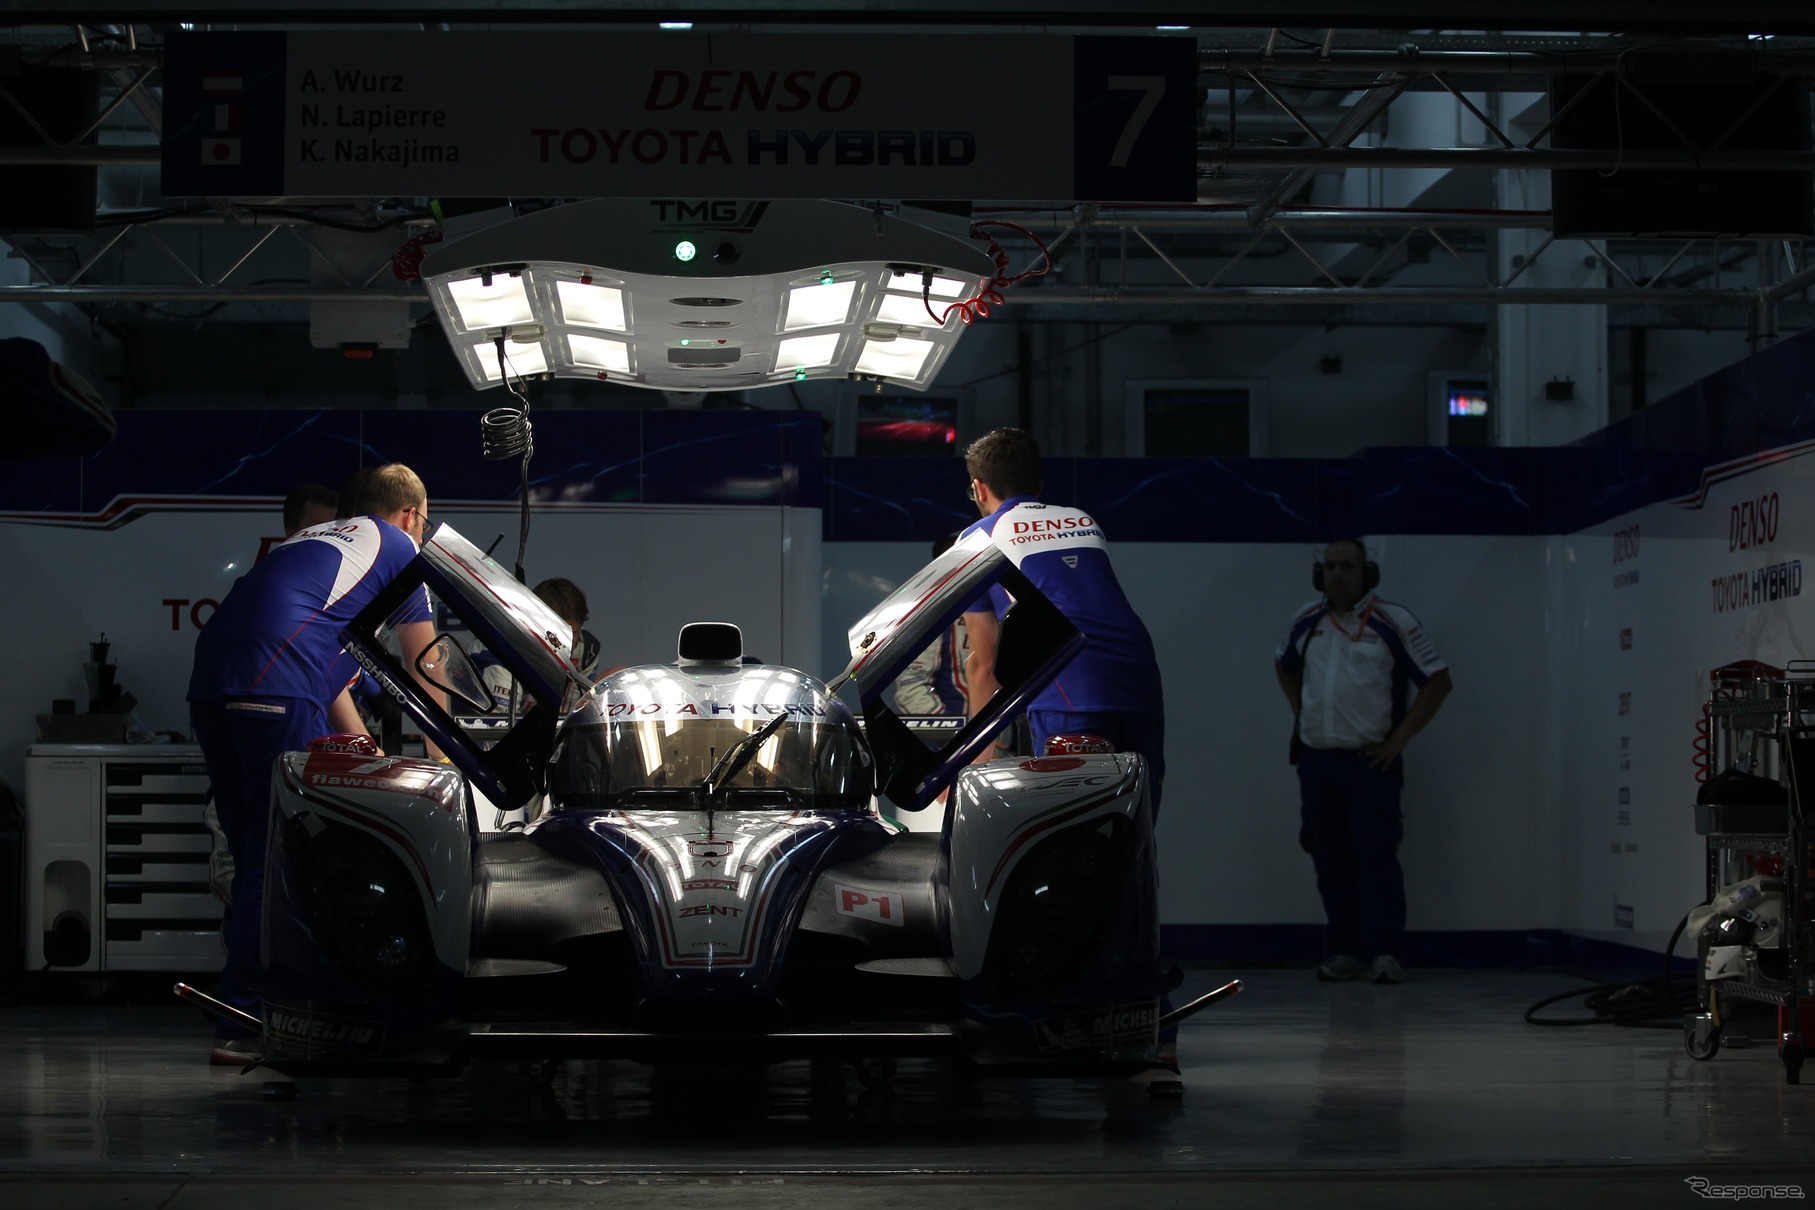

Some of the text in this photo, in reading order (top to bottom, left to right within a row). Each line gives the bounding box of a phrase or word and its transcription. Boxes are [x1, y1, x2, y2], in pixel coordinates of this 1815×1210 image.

[300, 70, 404, 92] A. Wurz
[643, 70, 862, 112] DENSO
[301, 104, 446, 132] N. Lapierre
[1107, 75, 1167, 168] 7
[301, 138, 460, 168] K. Nakajima
[530, 128, 977, 166] TOYOTA HYBRID
[650, 200, 737, 221] TMG
[1013, 516, 1094, 534] DENSO
[1729, 492, 1779, 553] DENSO
[1009, 533, 1056, 546] TOYOTA
[1711, 559, 1802, 613] TOYOTA HYBRID
[599, 703, 698, 717] TOYOA
[322, 742, 364, 754] TOTAL
[679, 905, 744, 918] ZENT
[841, 889, 891, 920] P1
[270, 1012, 376, 1044] MICHELIN
[1092, 1007, 1159, 1035] MICHELI
